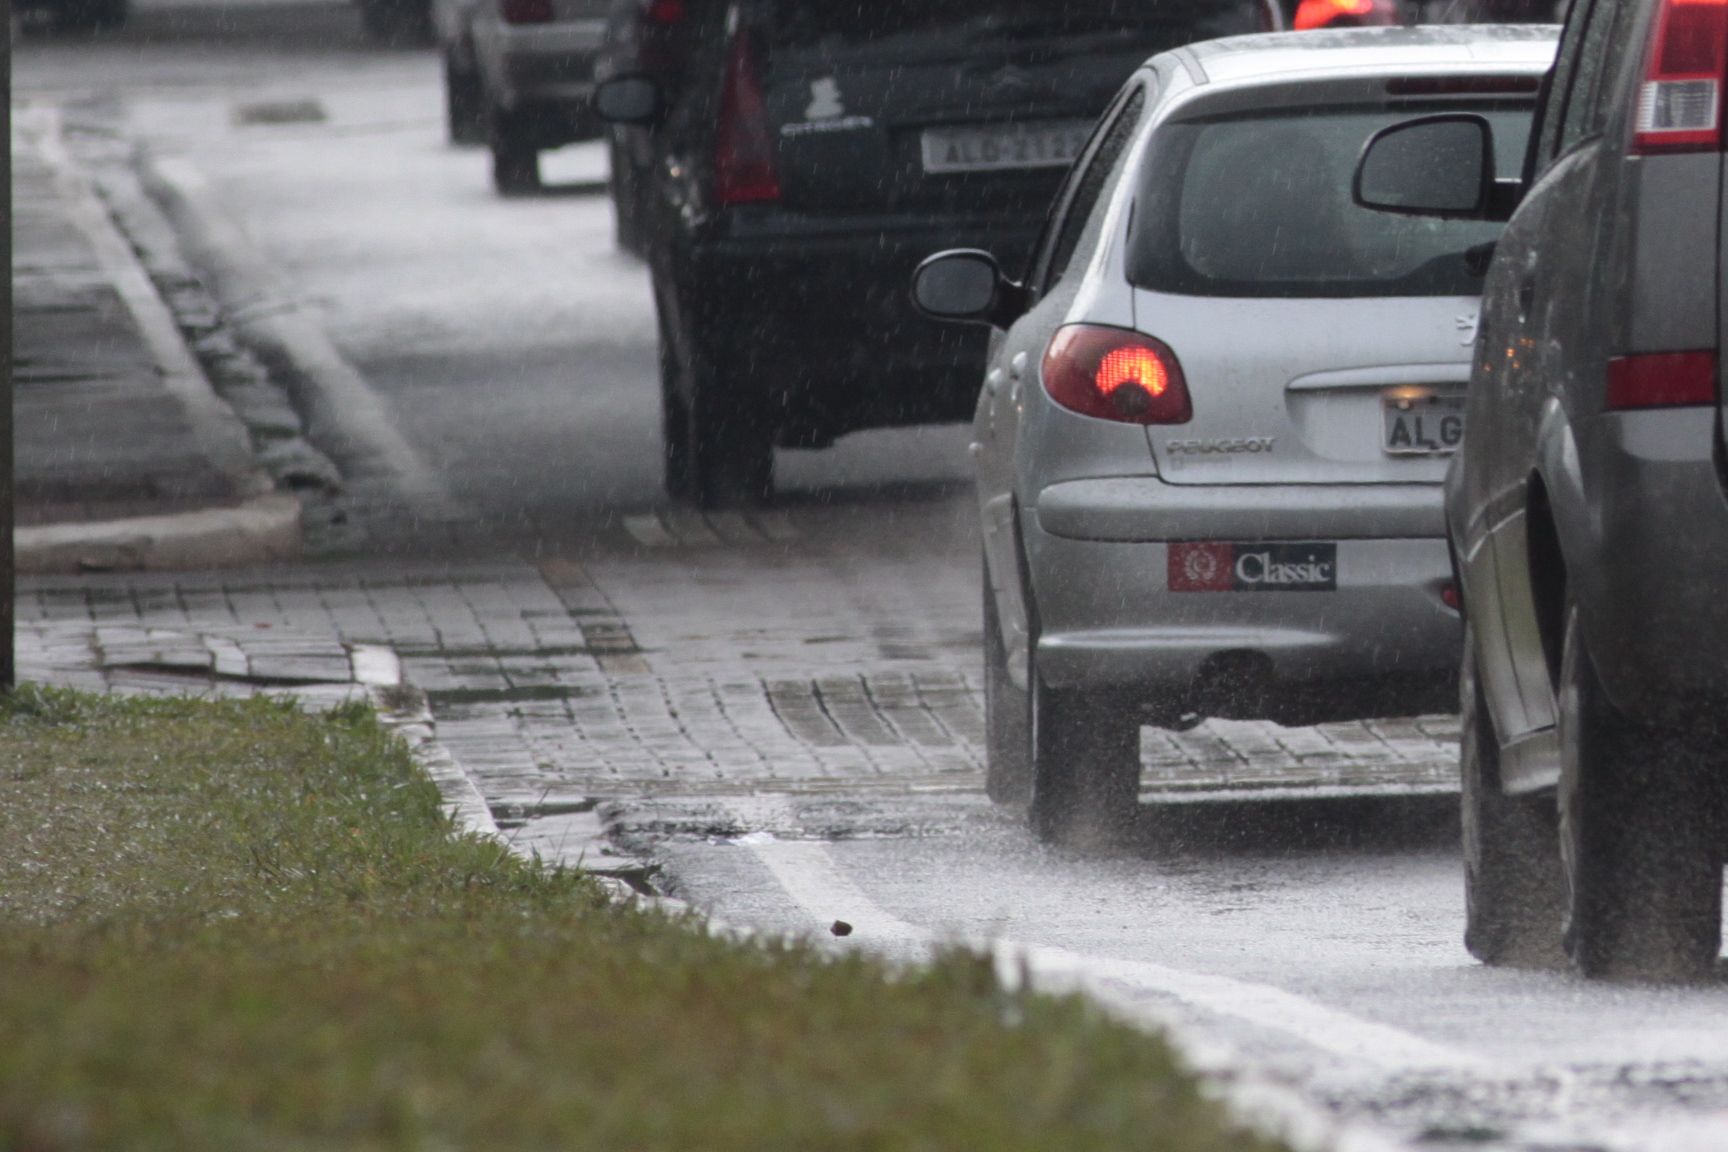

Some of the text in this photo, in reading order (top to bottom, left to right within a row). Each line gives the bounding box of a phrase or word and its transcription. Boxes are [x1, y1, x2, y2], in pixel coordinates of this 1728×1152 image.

[1165, 436, 1274, 456] PEUGEOT
[1389, 414, 1463, 448] ALG
[1236, 551, 1330, 584] Classic
